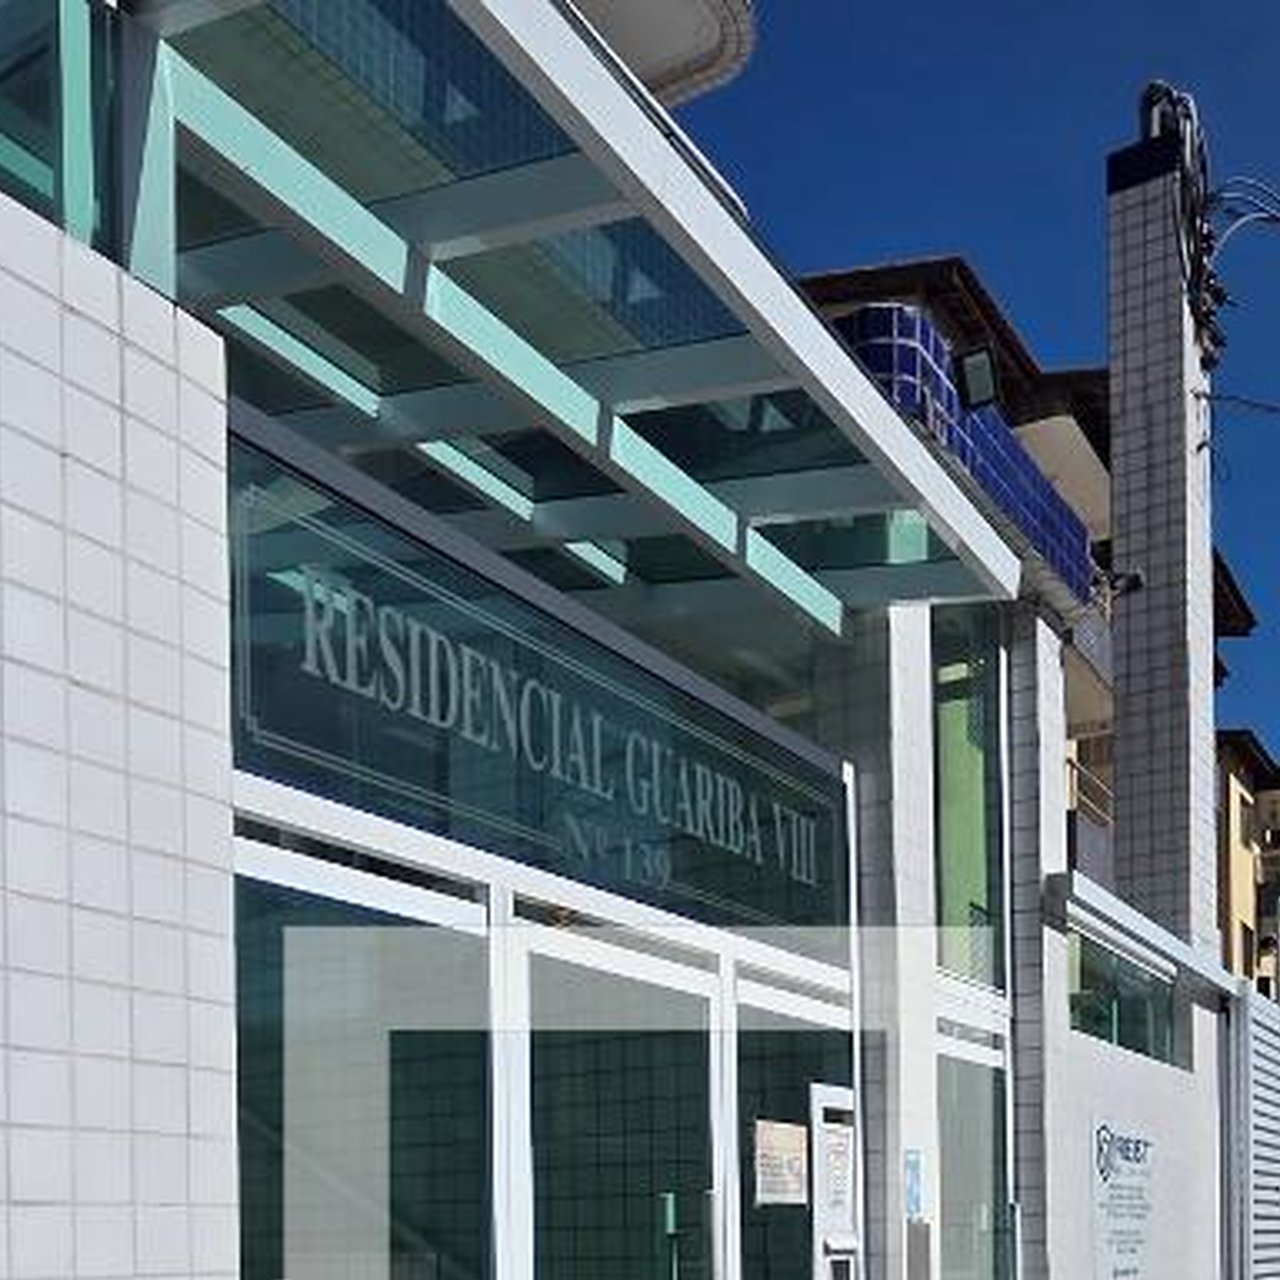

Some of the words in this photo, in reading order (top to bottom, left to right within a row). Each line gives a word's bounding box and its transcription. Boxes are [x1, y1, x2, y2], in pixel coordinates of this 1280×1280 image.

[300, 571, 614, 801] RESIDENCIAL
[625, 731, 763, 866] GUARIBA
[772, 802, 819, 886] VIII
